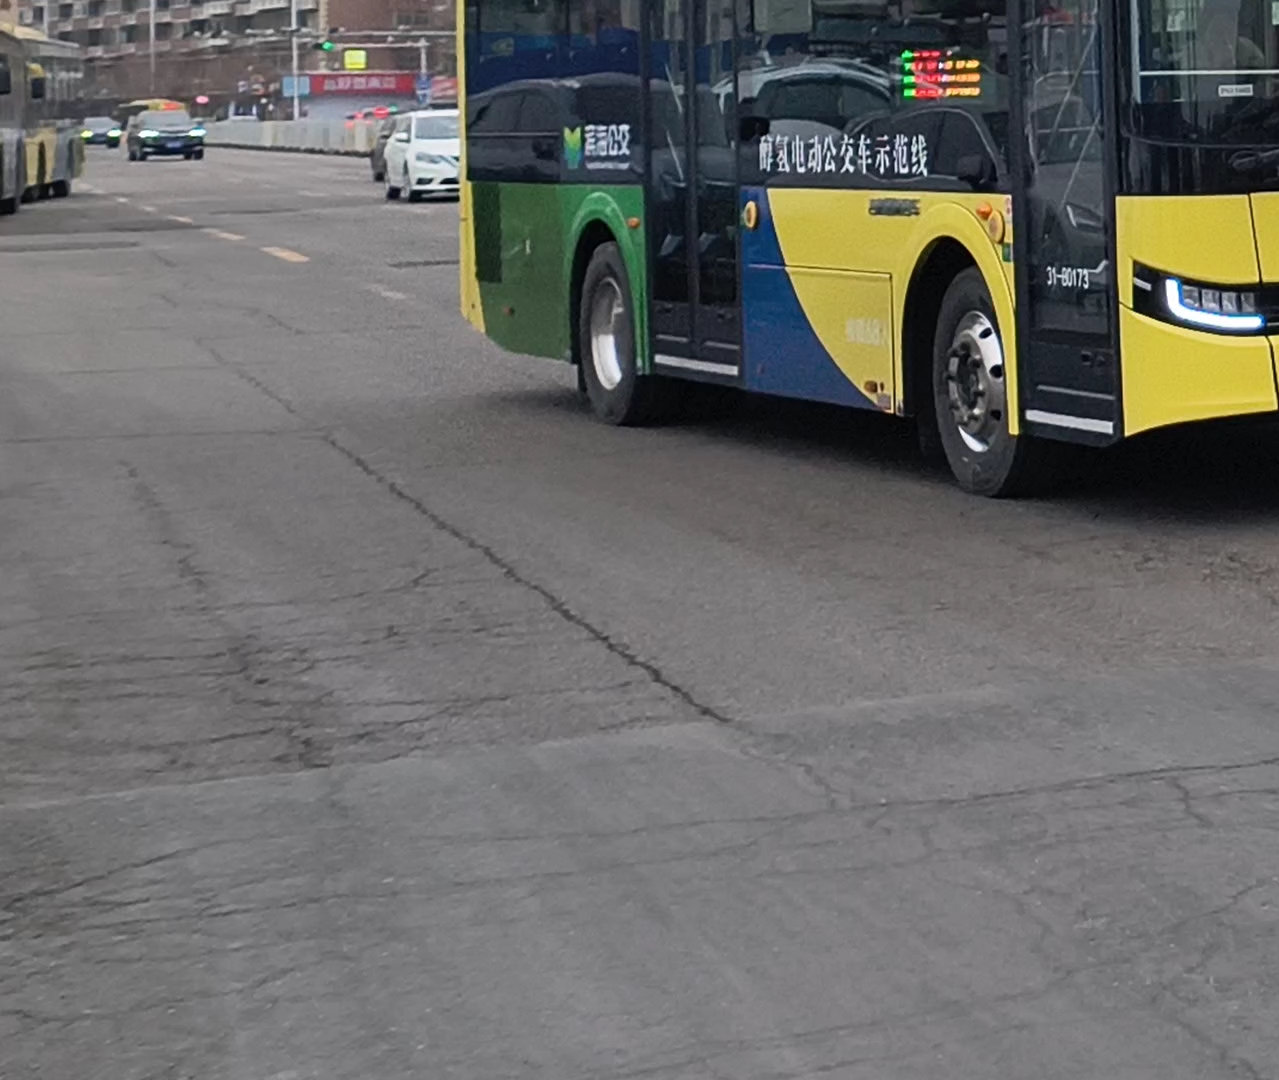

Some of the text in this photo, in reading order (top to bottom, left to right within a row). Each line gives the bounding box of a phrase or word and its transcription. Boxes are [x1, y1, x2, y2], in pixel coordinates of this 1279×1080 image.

[759, 133, 928, 176] 醇氢电动公交车示范线
